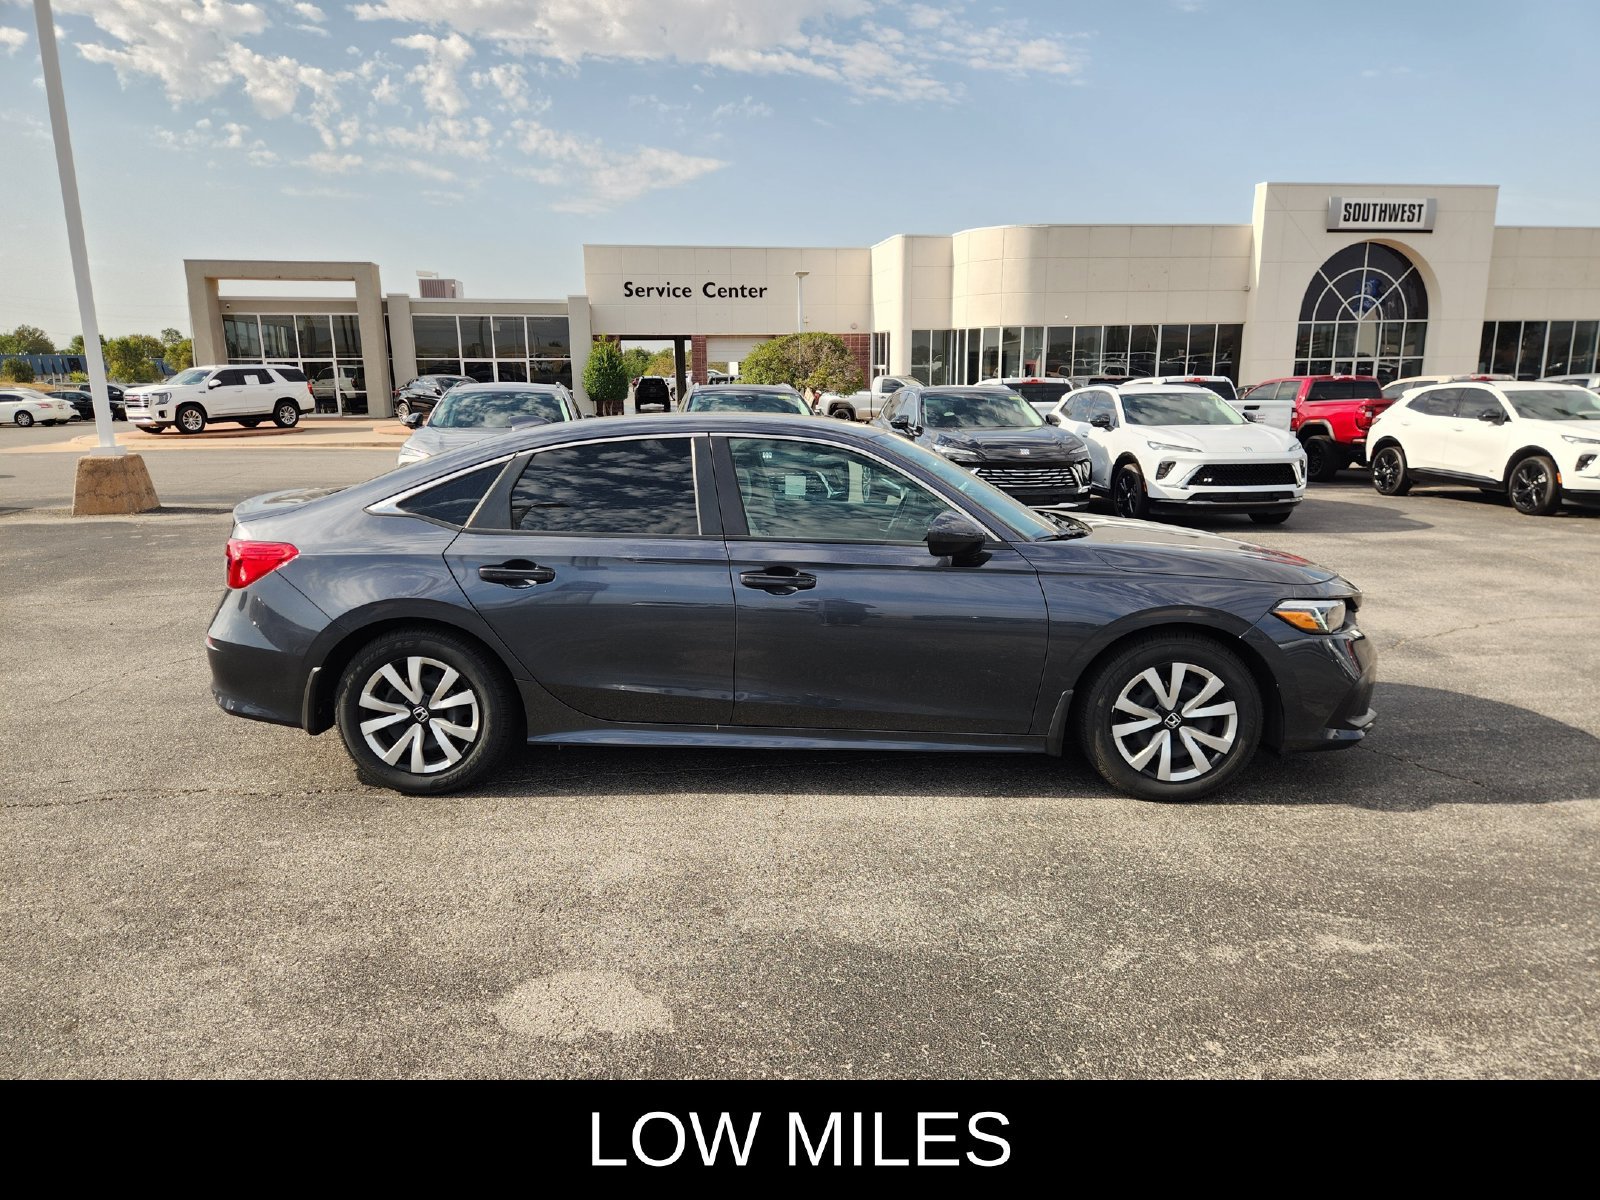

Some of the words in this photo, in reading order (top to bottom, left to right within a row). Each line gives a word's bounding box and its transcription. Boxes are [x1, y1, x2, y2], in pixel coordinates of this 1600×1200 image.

[1342, 202, 1425, 222] SOUTHWEST
[623, 281, 692, 298] Service
[702, 281, 768, 298] Center
